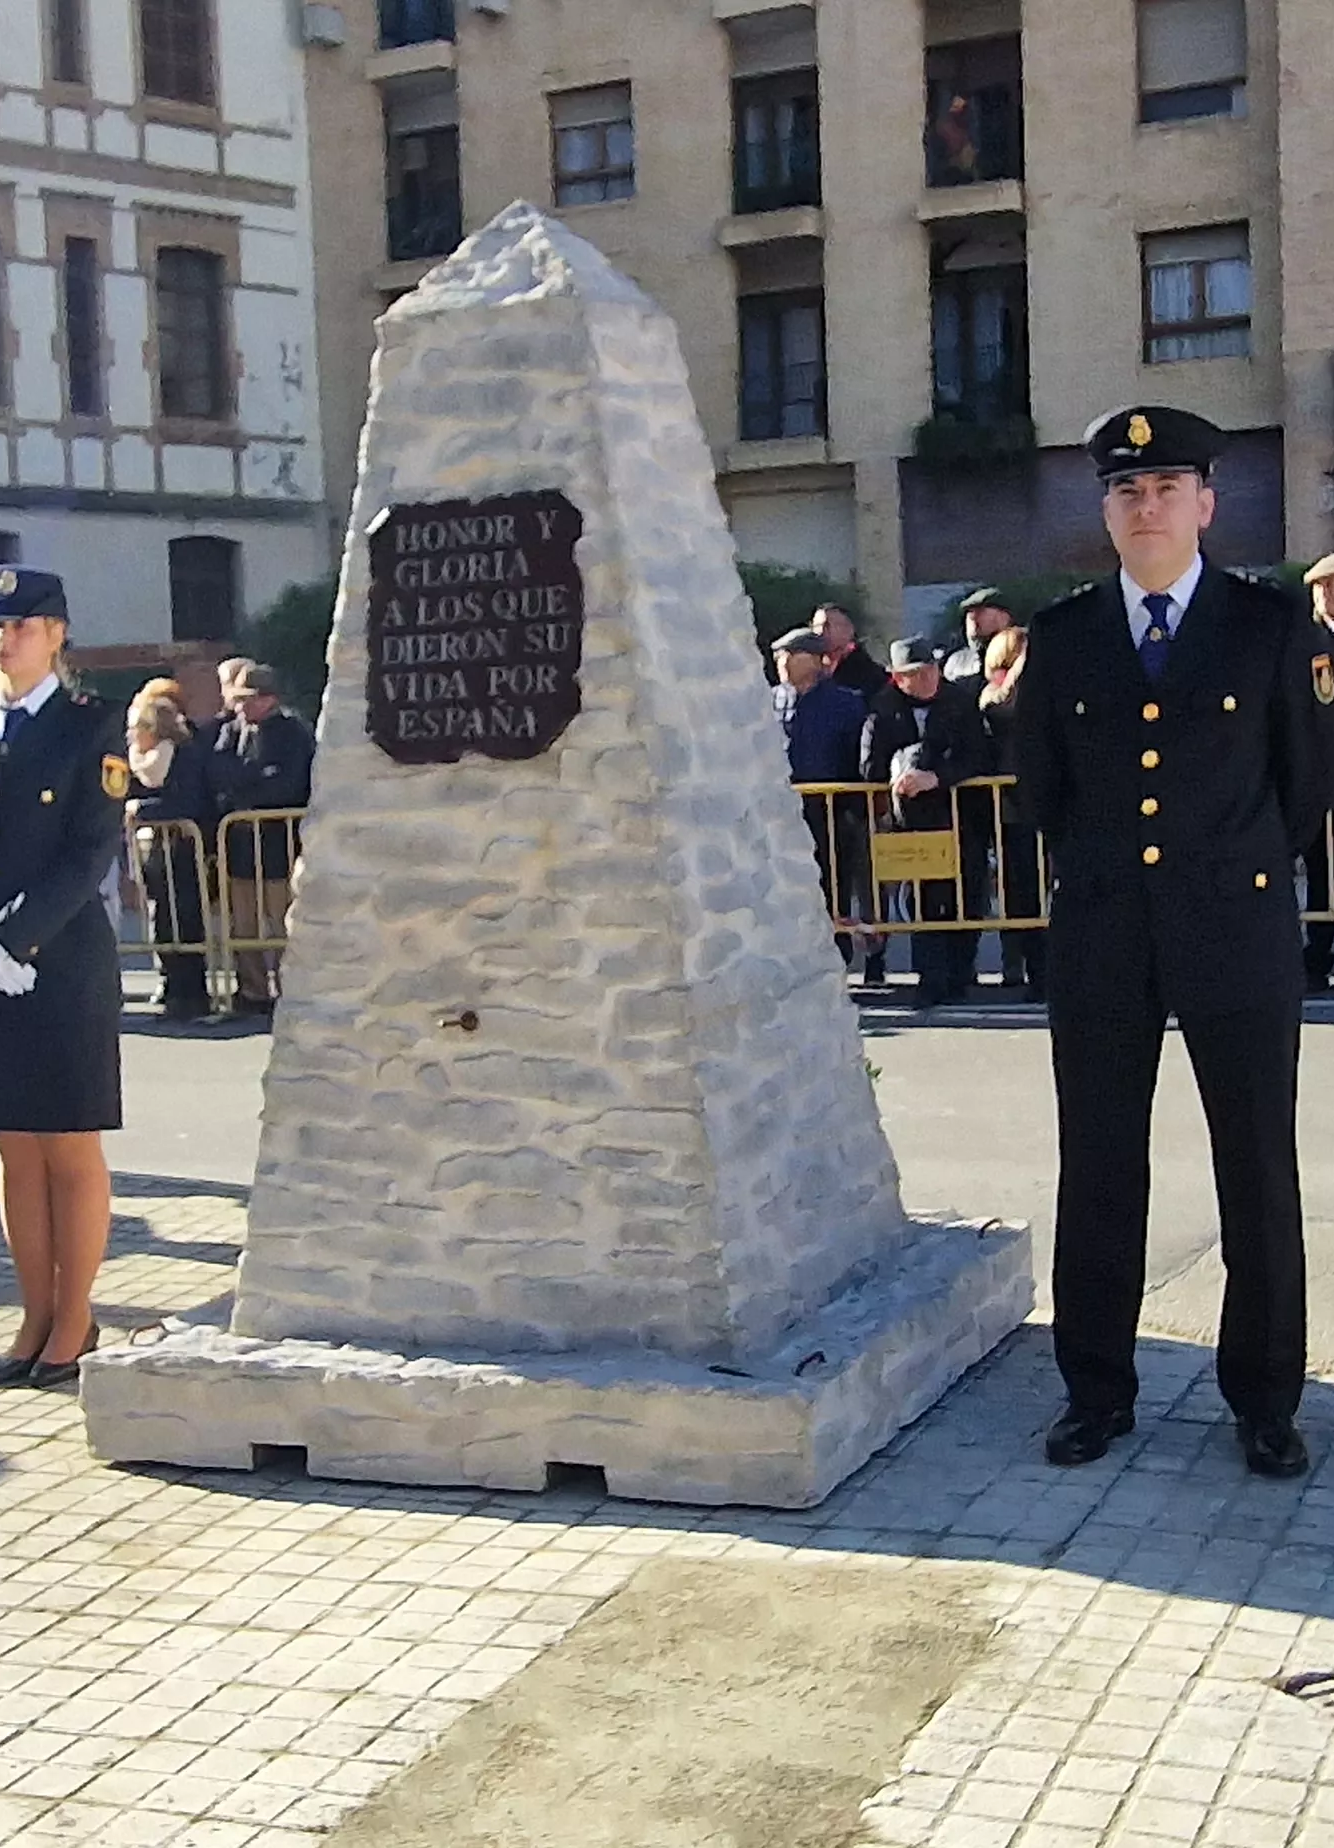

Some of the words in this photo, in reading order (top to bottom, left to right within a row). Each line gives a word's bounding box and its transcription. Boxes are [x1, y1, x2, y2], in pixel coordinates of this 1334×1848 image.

[395, 515, 515, 554] HONOR
[536, 510, 559, 540] Y
[395, 548, 530, 590] GLORIA
[382, 597, 406, 627] A
[417, 590, 485, 626] LOS
[492, 584, 568, 621] QUE
[382, 628, 508, 666] DIERON
[524, 623, 572, 654] SU
[381, 670, 467, 703] VIDA
[486, 664, 558, 696] POR
[397, 699, 537, 740] ESPAÑA
